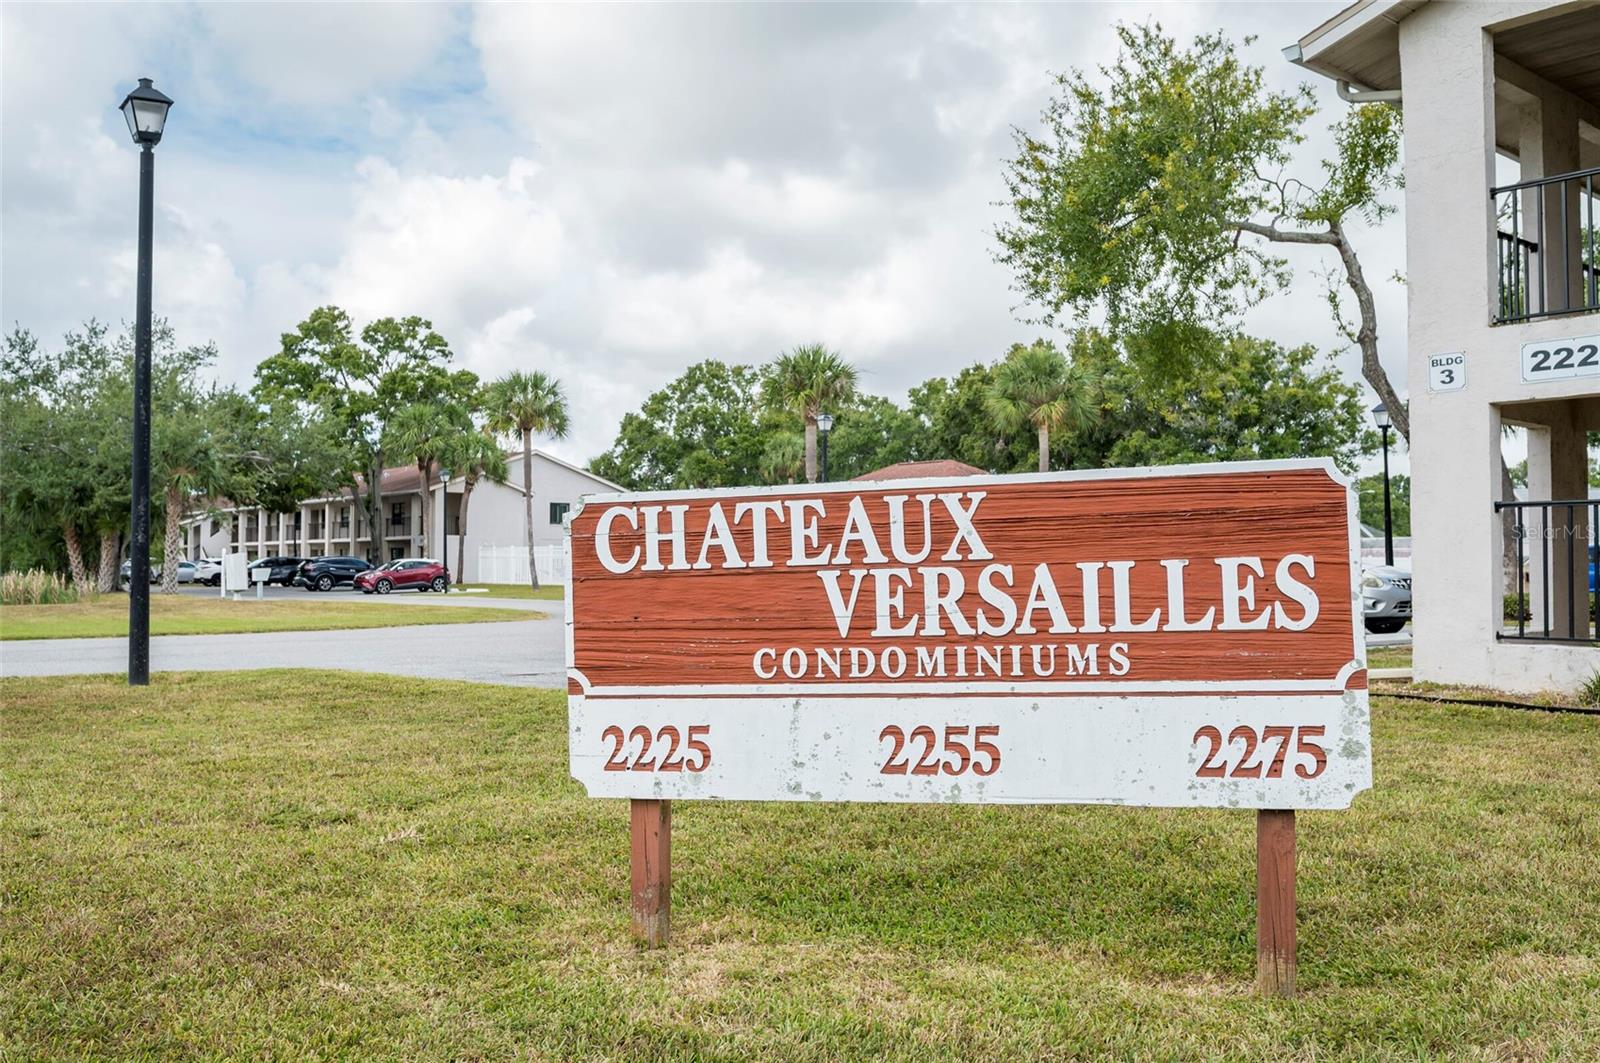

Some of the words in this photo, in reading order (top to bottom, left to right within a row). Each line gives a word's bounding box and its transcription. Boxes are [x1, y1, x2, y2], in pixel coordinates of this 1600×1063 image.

[1431, 356, 1463, 367] BLDG
[1440, 369, 1455, 384] 3
[594, 491, 994, 574] CHATEAUX
[816, 553, 1320, 638] VERSAILLES
[752, 642, 1131, 679] CONDOMINIUMS
[601, 725, 711, 773] 2225
[879, 725, 1002, 775] 2255
[1193, 725, 1327, 779] 2275
